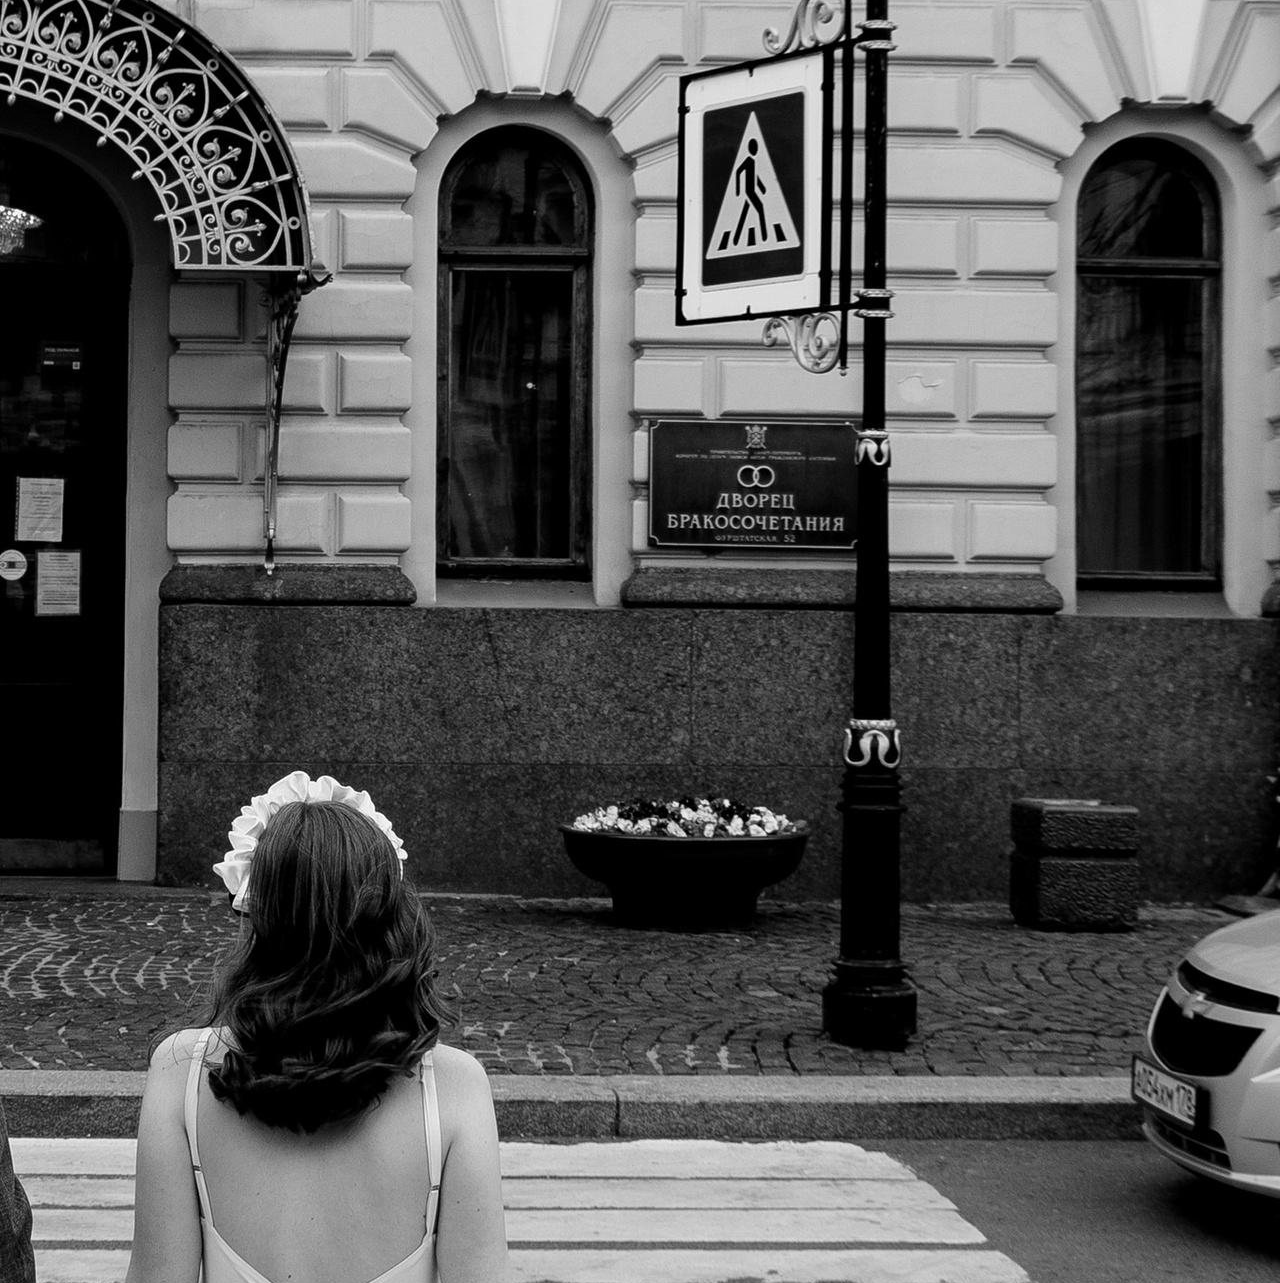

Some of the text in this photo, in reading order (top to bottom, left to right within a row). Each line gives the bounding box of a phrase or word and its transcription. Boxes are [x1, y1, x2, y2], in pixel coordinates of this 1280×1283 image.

[716, 493, 795, 510] ДВОРЕЦ
[667, 514, 844, 532] БРАКОСОЧЕТАНИЯ
[783, 534, 796, 543] 52
